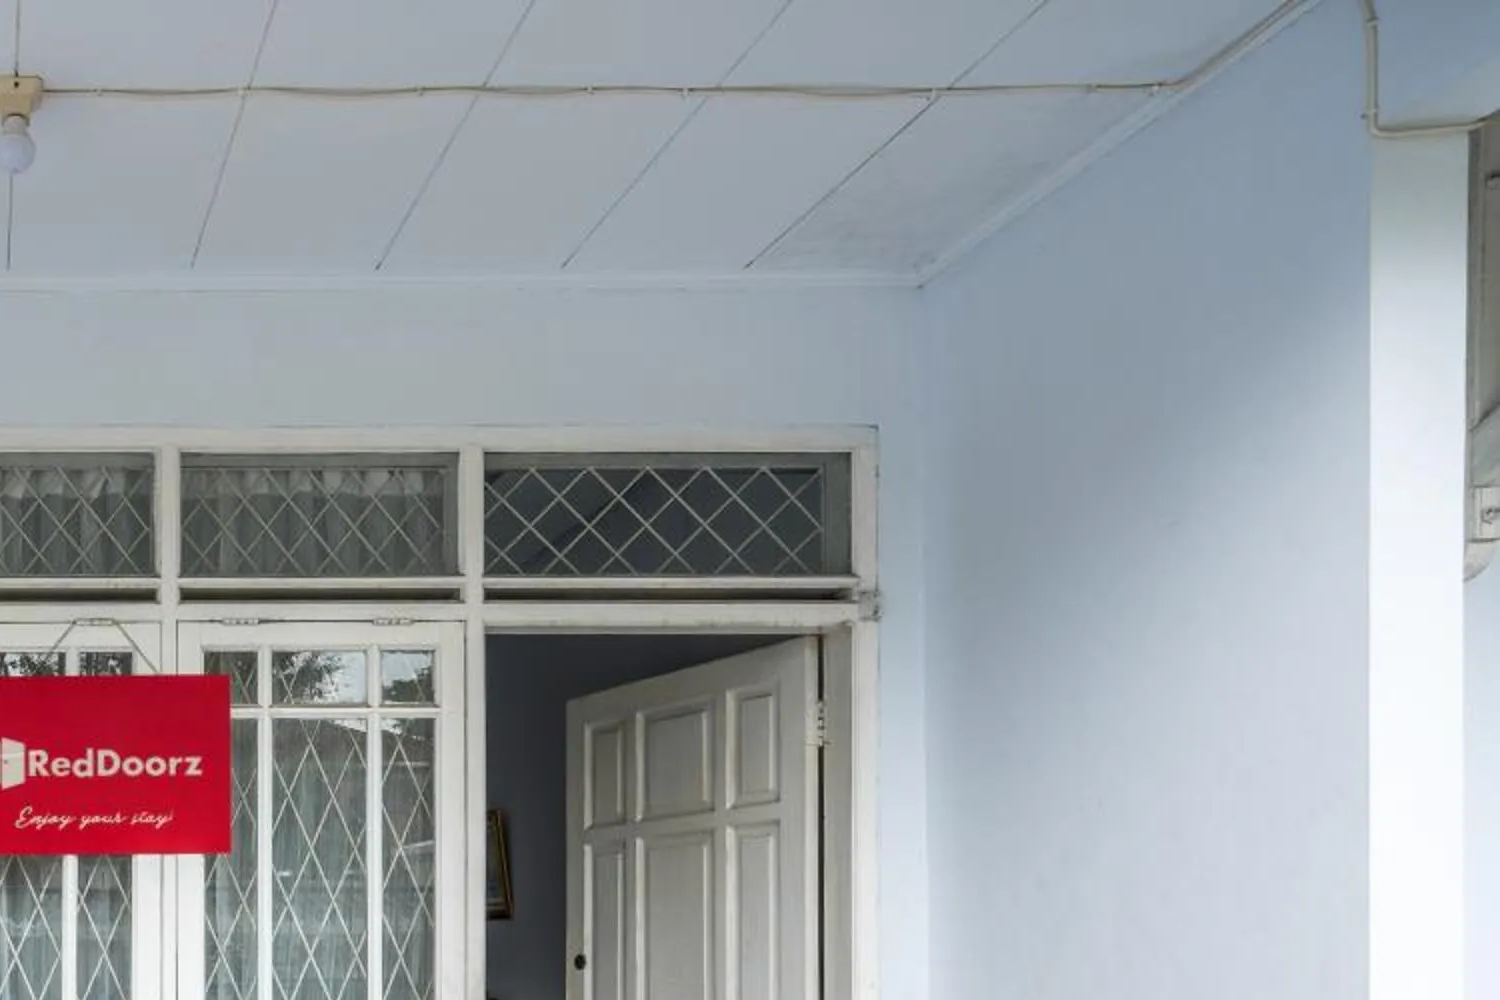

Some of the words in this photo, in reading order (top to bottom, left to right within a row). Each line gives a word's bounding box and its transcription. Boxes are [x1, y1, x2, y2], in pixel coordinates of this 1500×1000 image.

[28, 748, 203, 778] RedDoorz
[15, 805, 76, 831] Enjoy
[79, 811, 130, 830] your
